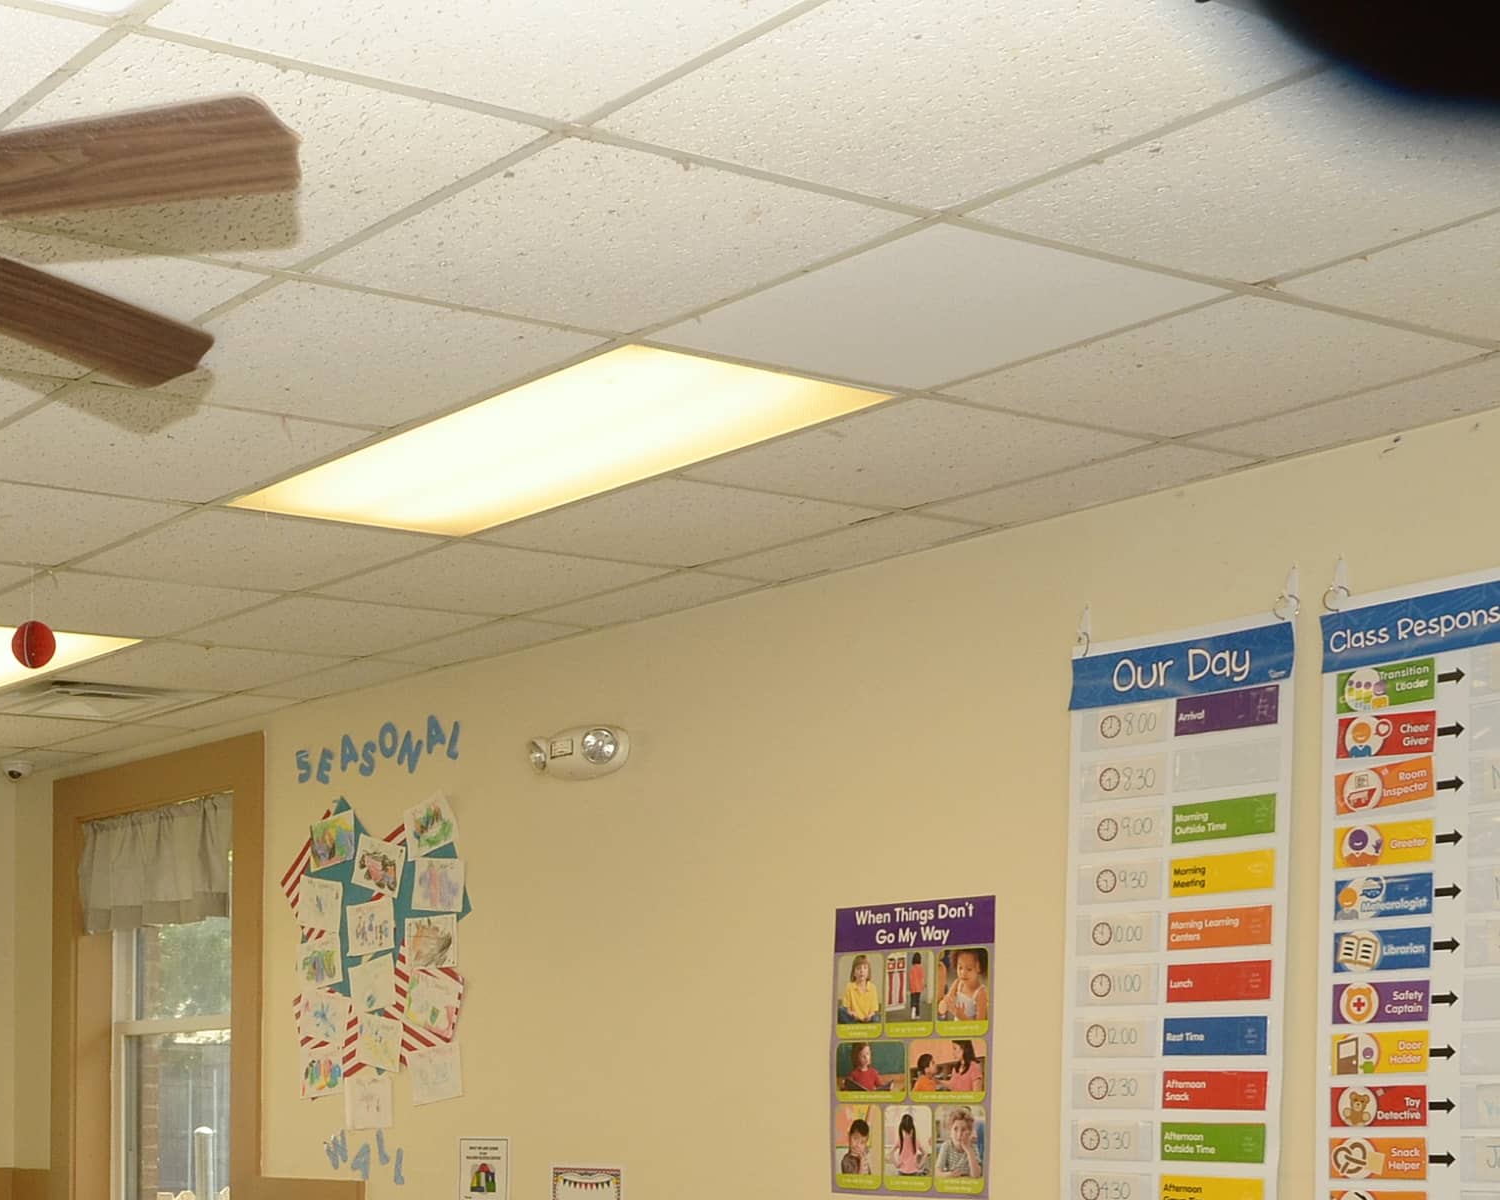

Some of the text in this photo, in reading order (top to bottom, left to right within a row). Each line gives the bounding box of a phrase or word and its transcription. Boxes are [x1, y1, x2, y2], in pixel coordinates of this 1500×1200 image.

[1330, 605, 1500, 653] Class Respons
[1112, 647, 1251, 692] Our Day
[1379, 664, 1429, 680] Transition
[1395, 678, 1429, 691] Leader
[1178, 709, 1204, 722] Arrival
[1400, 722, 1429, 734] Cheer
[1402, 735, 1429, 747] Giver
[296, 714, 460, 784] SEASONAL
[1398, 768, 1427, 781] Room
[1382, 781, 1428, 798] Inspector
[1175, 811, 1209, 824] Morning
[1175, 821, 1227, 835] Outside Time
[1390, 837, 1427, 850] Greeter
[1173, 865, 1206, 878] Morning
[1173, 877, 1206, 889] Meeting
[1360, 899, 1428, 914] Meteorologist
[855, 902, 974, 926] When Things Don't
[1171, 916, 1239, 930] Morning Learning
[875, 926, 950, 945] Go My Way
[1170, 931, 1201, 943] Centers
[1382, 943, 1426, 955] Librarian
[1169, 978, 1193, 989] Lunch
[1393, 990, 1424, 1002] Safety
[1385, 1002, 1423, 1015] Captain
[1166, 1031, 1204, 1042] Rest Time
[1398, 1040, 1422, 1051] Door
[1390, 1053, 1422, 1065] Holder
[1165, 1079, 1206, 1090] Afternoon
[1165, 1092, 1190, 1102] Snack
[1404, 1097, 1421, 1109] Toy
[1377, 1110, 1421, 1121] Detective
[1164, 1131, 1204, 1143] Afternoon
[1164, 1144, 1216, 1155] Outside Time
[1391, 1148, 1420, 1158] Snack
[1388, 1160, 1421, 1172] Helper
[1163, 1183, 1202, 1195] Afternoon
